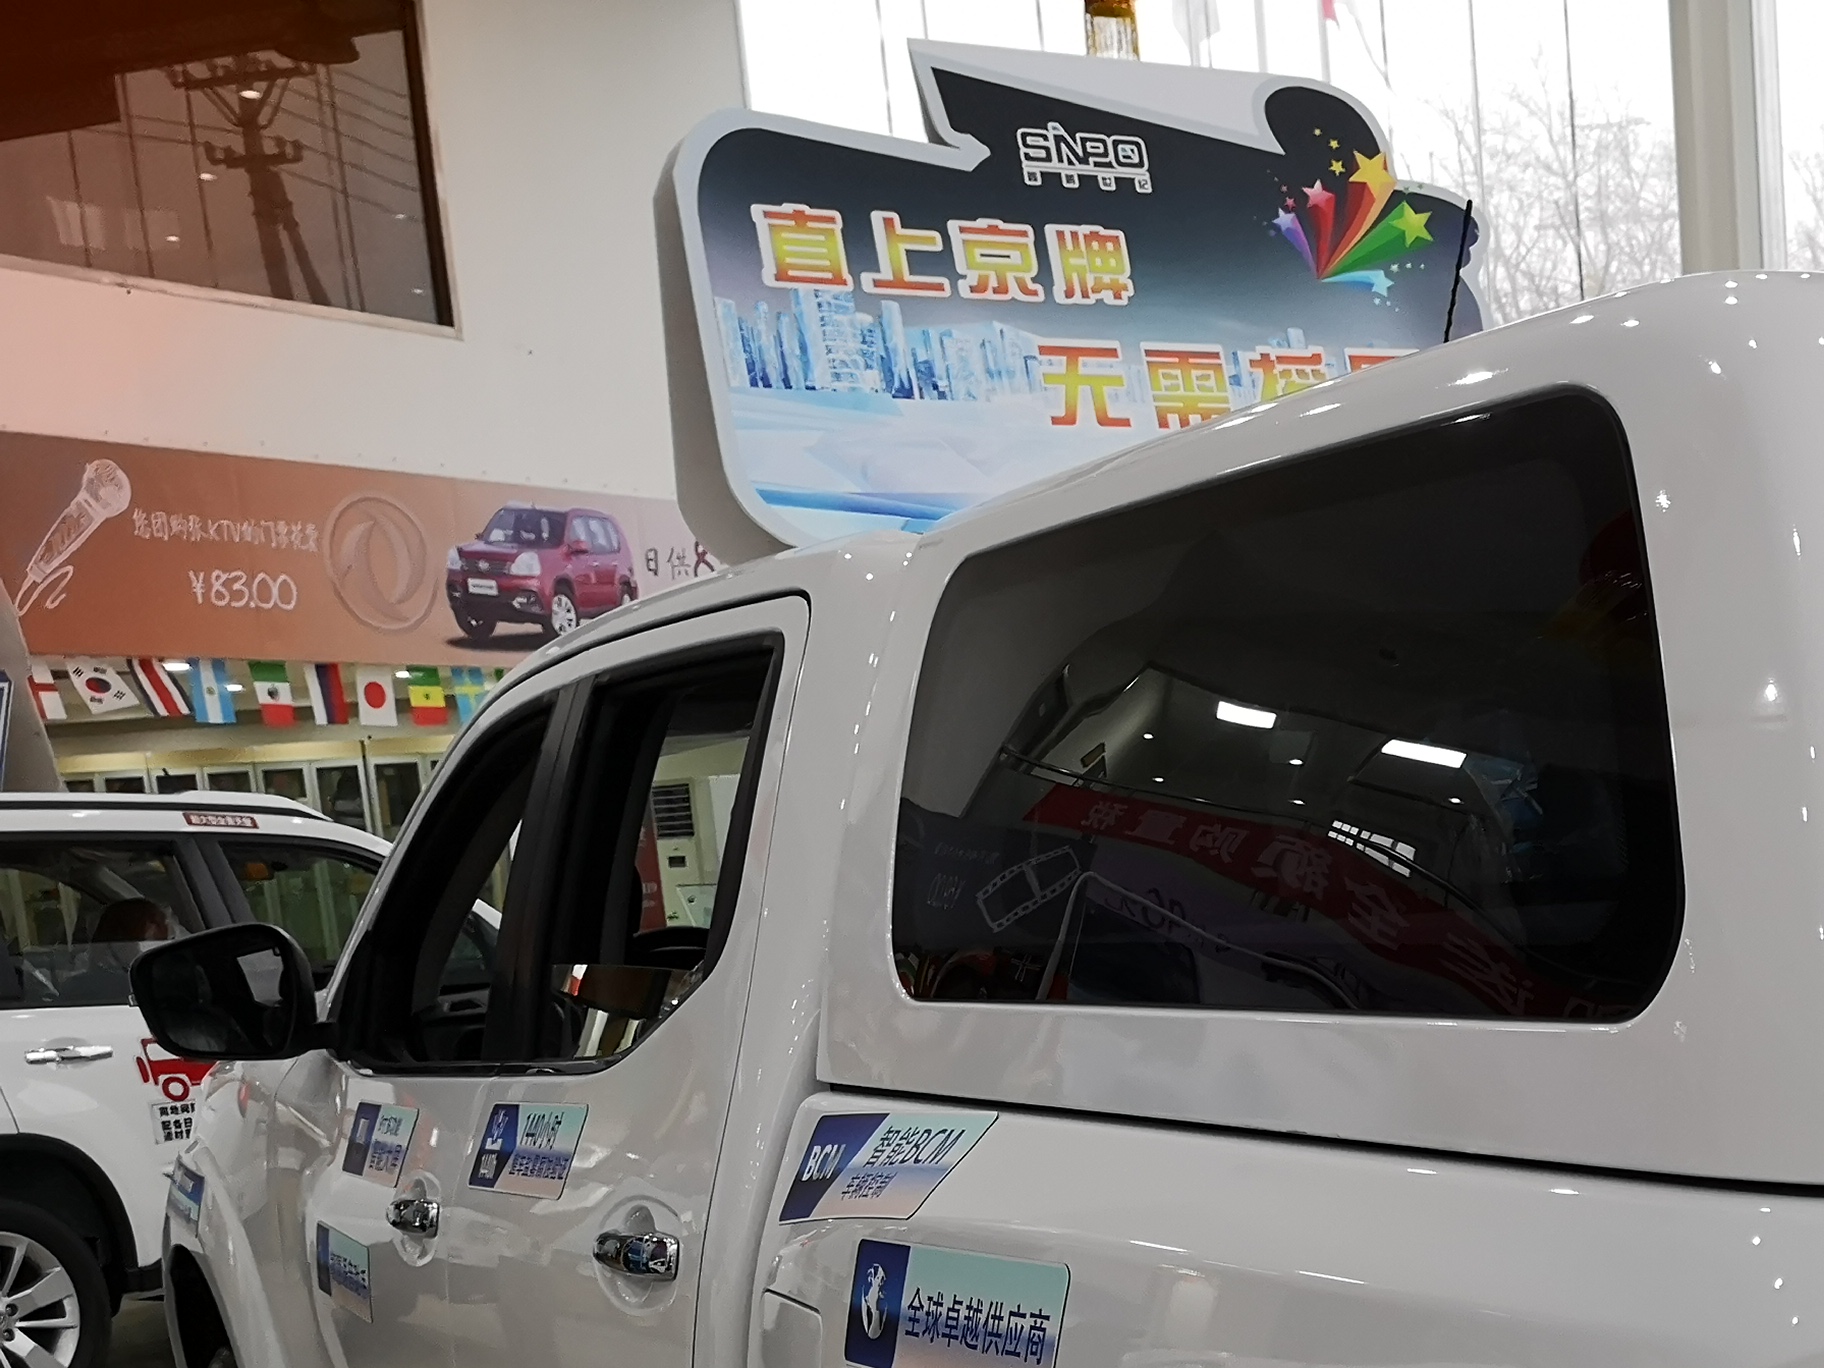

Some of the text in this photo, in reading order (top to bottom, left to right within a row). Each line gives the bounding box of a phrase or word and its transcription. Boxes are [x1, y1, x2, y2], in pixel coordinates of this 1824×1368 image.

[752, 204, 1135, 306] 直上京牌
[1036, 340, 1416, 430] 无需摇
[801, 1142, 847, 1183] BCM
[862, 1125, 966, 1169] 智能BCM
[904, 1286, 1051, 1366] 全球卓越供应商
